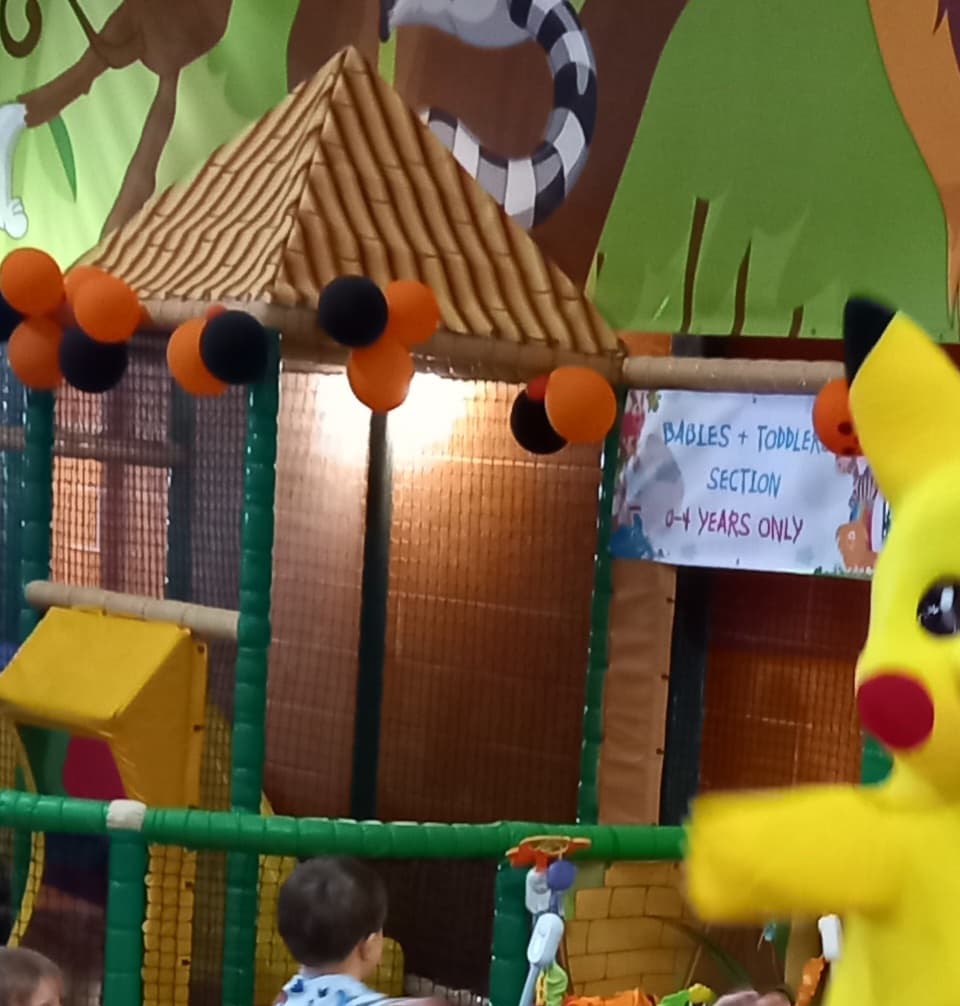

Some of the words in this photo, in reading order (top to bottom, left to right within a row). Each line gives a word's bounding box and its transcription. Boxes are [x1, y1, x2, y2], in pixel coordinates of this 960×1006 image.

[663, 420, 731, 447] BABIES
[707, 467, 781, 497] SECTION
[665, 508, 690, 530] 0-4
[697, 507, 750, 538] YEARS
[758, 515, 803, 544] ONLY
